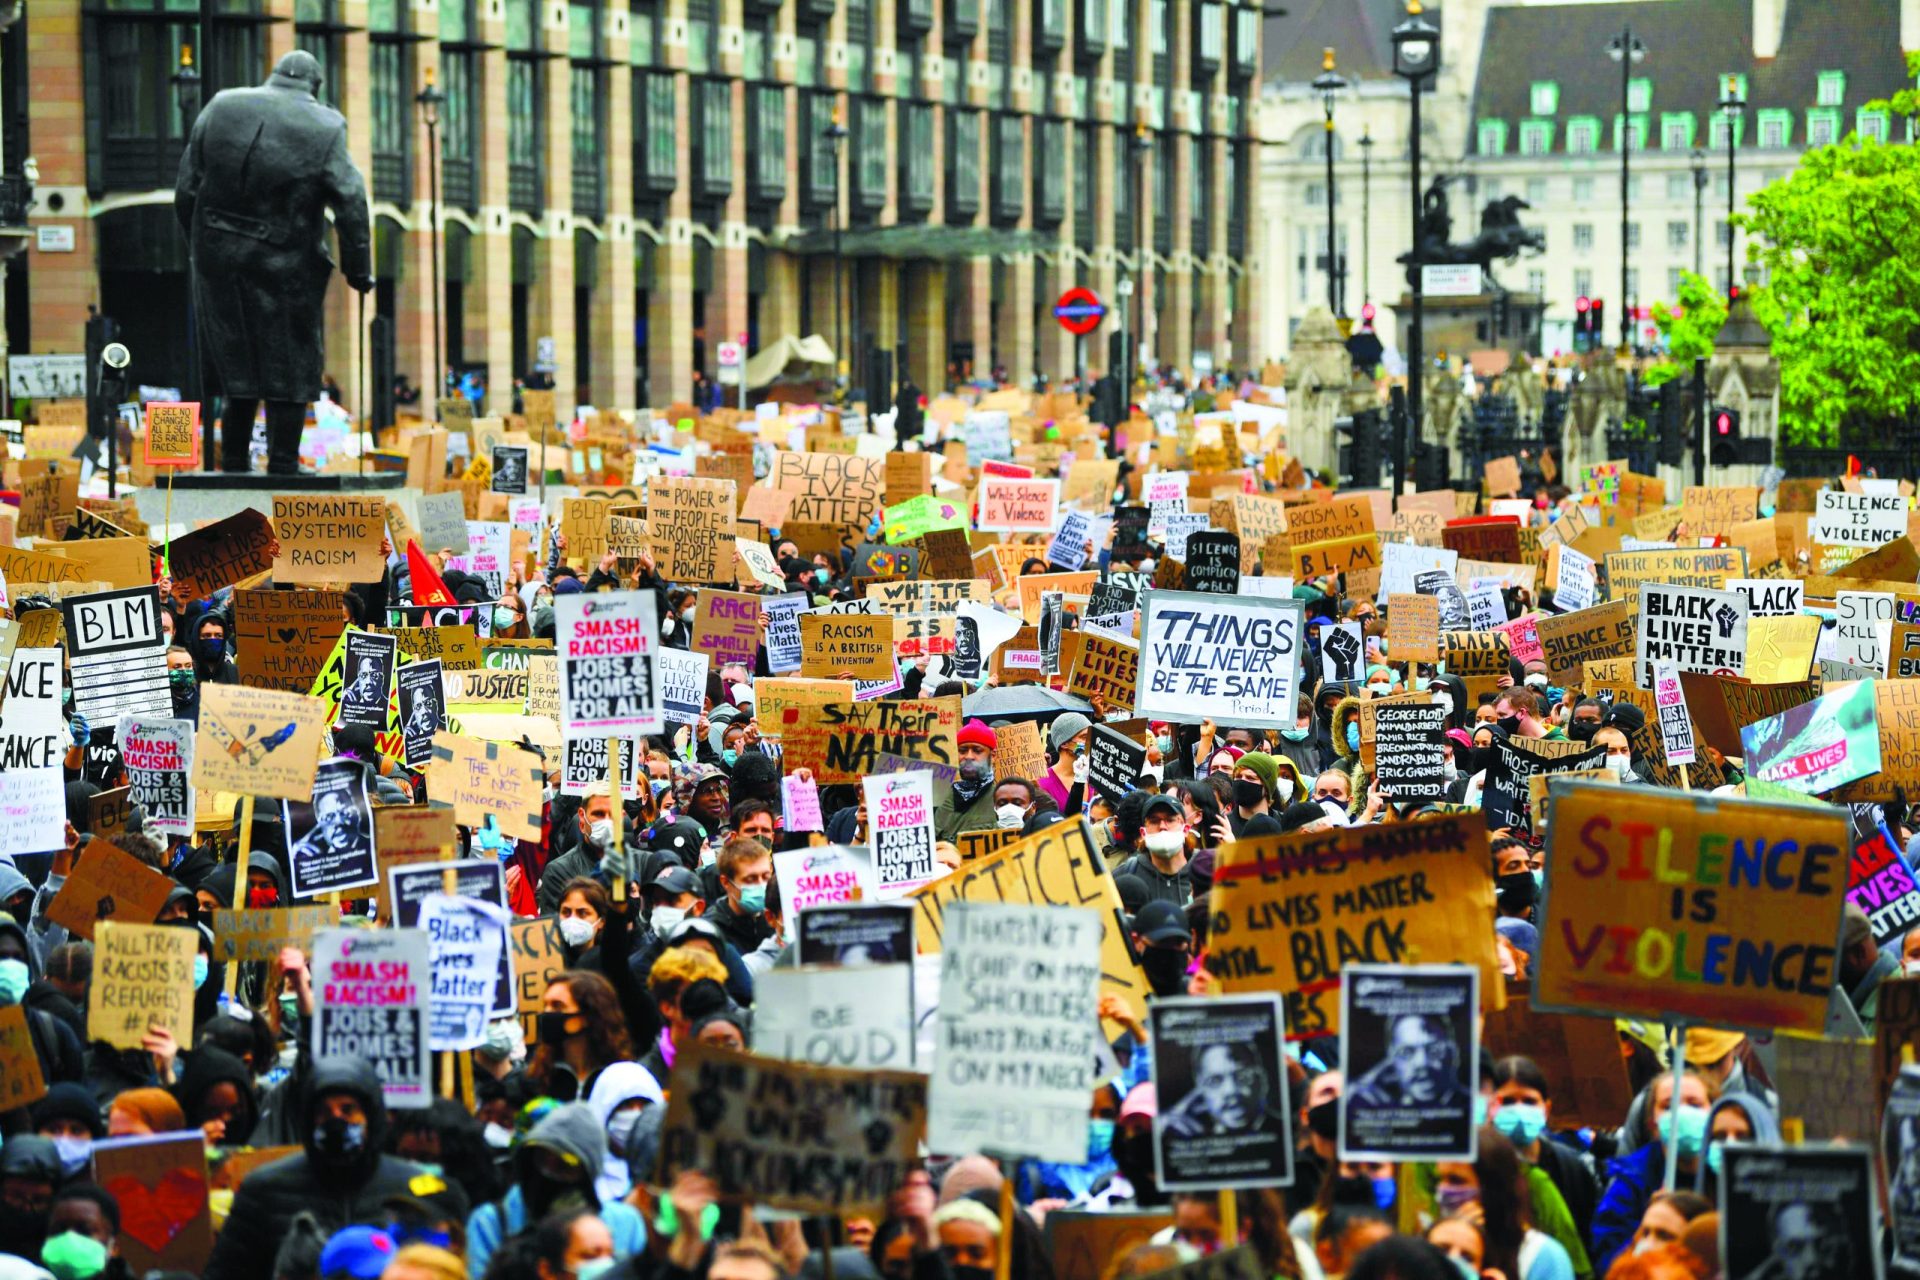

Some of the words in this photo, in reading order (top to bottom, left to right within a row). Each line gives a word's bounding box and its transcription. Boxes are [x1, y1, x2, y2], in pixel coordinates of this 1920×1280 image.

[154, 416, 190, 425] CHANGES
[180, 408, 190, 416] NO
[152, 425, 162, 433] ALL
[166, 425, 171, 433] I
[174, 425, 188, 433] SEE
[152, 434, 162, 442] IS
[166, 434, 192, 442] RACIST
[780, 453, 879, 483] BLACK
[24, 478, 61, 497] WHAT
[35, 499, 60, 513] HAS
[654, 489, 670, 497] THE
[674, 488, 715, 508] POWER
[718, 494, 729, 503] OF
[1236, 495, 1279, 517] BLACK
[1687, 489, 1736, 506] BLACK
[1824, 494, 1901, 510] SILENCE
[275, 502, 381, 517] DISMANTLE
[1290, 508, 1336, 527] RACISM
[1345, 503, 1359, 518] IS
[611, 518, 646, 535] BLACK
[654, 509, 670, 519] THE
[674, 510, 718, 529] PEOPLE
[720, 515, 728, 524] IS
[1065, 515, 1088, 531] Black
[1168, 515, 1197, 524] BLACK
[1199, 515, 1207, 523] IS
[1395, 513, 1437, 530] BLACK
[1852, 513, 1869, 525] IS
[281, 523, 367, 539] SYSTEMIC
[484, 526, 499, 535] UK
[606, 534, 639, 544] LIVES
[653, 524, 716, 546] STRONGER
[718, 533, 736, 542] THAN
[1061, 525, 1083, 541] Lives
[1821, 526, 1902, 542] VIOLENCE
[608, 545, 648, 556] MATTER
[1056, 534, 1085, 551] Matter
[1191, 543, 1237, 558] SILENCE
[292, 551, 356, 565] RACISM
[652, 546, 669, 554] THE
[674, 544, 718, 563] PEOPLE
[1210, 557, 1221, 568] IS
[655, 562, 664, 570] IN
[672, 561, 715, 580] POWER
[1561, 554, 1586, 572] Black
[1611, 556, 1648, 572] THERE
[1657, 557, 1669, 570] IS
[1673, 556, 1691, 570] NO
[1694, 555, 1736, 572] PRIDE
[195, 551, 267, 594] MATTER
[1561, 566, 1583, 581] Lives
[884, 582, 971, 600] WHITE
[1105, 589, 1122, 598] END
[1560, 576, 1590, 595] Matter
[237, 593, 282, 609] LET'S
[289, 593, 344, 609] REWRITE
[1090, 596, 1133, 611] SYSTEMIC
[1647, 592, 1716, 622] BLACK
[81, 598, 150, 643] BLM
[240, 614, 260, 623] THE
[264, 614, 296, 623] SCRIPT
[302, 614, 343, 622] THROUGH
[767, 609, 795, 622] Black
[387, 628, 411, 637] YOU
[419, 627, 440, 637] ARE
[573, 619, 639, 638] SMASH
[768, 624, 797, 634] Lives
[822, 624, 873, 639] RACISM
[907, 620, 940, 638] IS
[1156, 610, 1294, 655] THINGS
[1647, 618, 1712, 646] LIVES
[569, 637, 647, 656] RACISM!
[699, 634, 750, 651] SMALL
[815, 643, 824, 652] IS
[829, 642, 836, 652] A
[841, 642, 883, 653] BRITISH
[1446, 633, 1507, 651] BLACK
[1545, 627, 1606, 656] SILENCE
[1615, 621, 1632, 637] IS
[285, 645, 305, 653] AND
[1086, 638, 1139, 667] BLACK
[1550, 639, 1635, 672] COMPLIANCE
[1646, 641, 1742, 669] MATTER!!
[264, 656, 323, 672] HUMAN
[660, 658, 702, 674] BLACK
[831, 656, 875, 665] INVENTION
[1154, 643, 1208, 670] WILL
[1210, 649, 1277, 674] NEVER
[1448, 651, 1510, 669] LIVES
[572, 658, 627, 680] JOBS
[631, 657, 647, 675] &
[1083, 654, 1137, 684] LIVES
[572, 676, 648, 699] HOMES
[664, 673, 695, 688] LIVES
[1073, 672, 1135, 705] MATTER
[1151, 670, 1179, 693] BE
[1186, 672, 1218, 696] THE
[1224, 676, 1288, 699] SAME
[661, 686, 701, 703] MATTER
[569, 699, 610, 720] FOR
[615, 696, 653, 716] ALL
[1232, 700, 1275, 715] Period.
[1377, 710, 1417, 721] GEORGE
[1419, 708, 1445, 720] FLOYD
[816, 703, 874, 726] SAY
[877, 703, 938, 733] Their
[1376, 733, 1404, 741] TAMIR
[1406, 733, 1427, 741] RICE
[1664, 721, 1687, 735] HOMES
[126, 737, 177, 755] SMASH
[573, 739, 609, 752] JOBS
[618, 741, 629, 755] &
[826, 732, 950, 775] NAMES
[1095, 737, 1119, 756] RACISM
[1120, 752, 1129, 762] IS
[1512, 737, 1584, 757] INJUSTICE
[123, 754, 182, 769] RACISM!
[464, 758, 489, 774] THE
[498, 766, 518, 778] UK
[1376, 754, 1415, 765] SANDRA
[1415, 753, 1444, 764] BLAND
[1757, 762, 1798, 782] BLACK
[1805, 747, 1844, 770] LIVES
[1377, 767, 1405, 778] ERIC
[1406, 767, 1444, 777] GARNER
[470, 777, 480, 787] IS
[492, 778, 521, 793] NOT
[454, 789, 523, 811] INNOCENT
[880, 795, 922, 813] SMASH
[156, 804, 187, 819] ALL
[878, 809, 926, 829] RACISM!
[879, 830, 915, 848] JOBS
[917, 831, 928, 843] &
[880, 844, 928, 867] HOMES
[1257, 835, 1350, 885] LIVES
[1362, 819, 1469, 871] MATTER
[1572, 815, 1839, 896] SILENCE
[878, 863, 908, 882] FOR
[909, 860, 933, 879] ALL
[796, 872, 858, 895] SMASH
[1247, 892, 1321, 930] LIVES
[1333, 872, 1436, 918] MATTER
[1671, 887, 1717, 923] IS
[429, 917, 482, 943] Black
[1290, 917, 1409, 984] BLACK
[1561, 919, 1835, 997] VIOLENCE
[102, 958, 170, 982] RACISTS
[331, 961, 408, 983] SMASH
[324, 984, 416, 1006] RACISM!
[327, 1009, 388, 1033] JOBS
[397, 1009, 414, 1033] &
[810, 1005, 854, 1030] BE
[327, 1032, 413, 1058] HOMES
[376, 1059, 420, 1082] ALL
